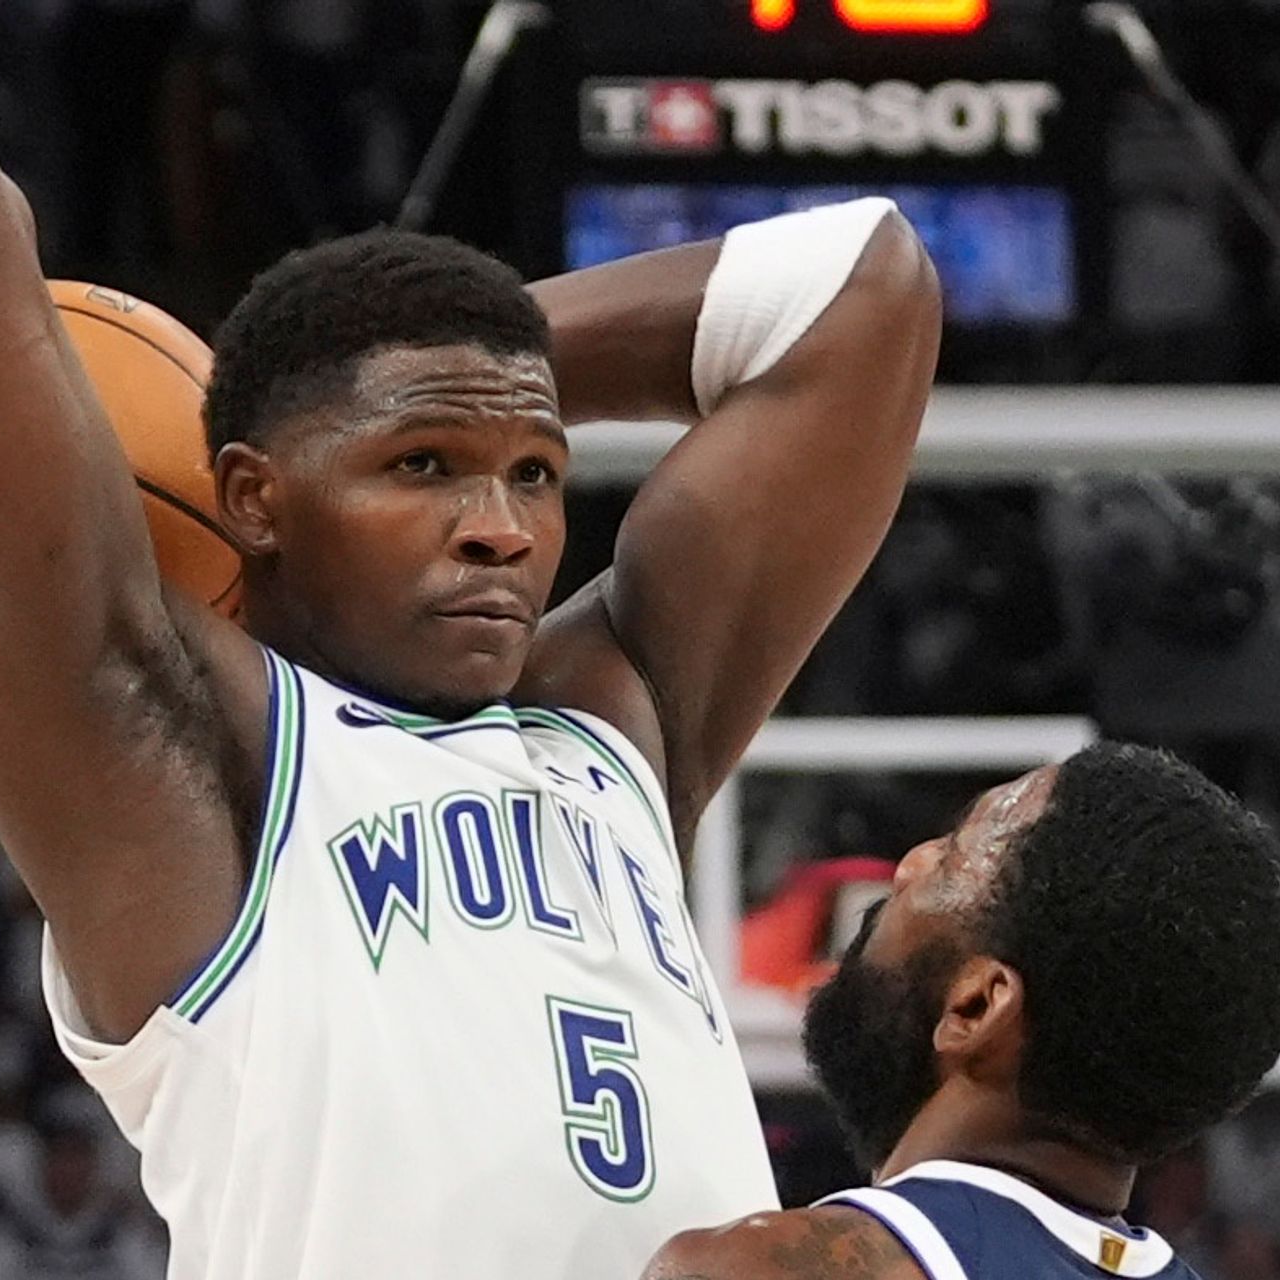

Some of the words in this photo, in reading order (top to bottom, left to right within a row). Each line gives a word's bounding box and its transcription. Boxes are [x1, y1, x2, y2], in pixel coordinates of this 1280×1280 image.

[716, 78, 1060, 155] TISSOT
[327, 786, 722, 1044] WOLVE
[545, 994, 657, 1204] 5
